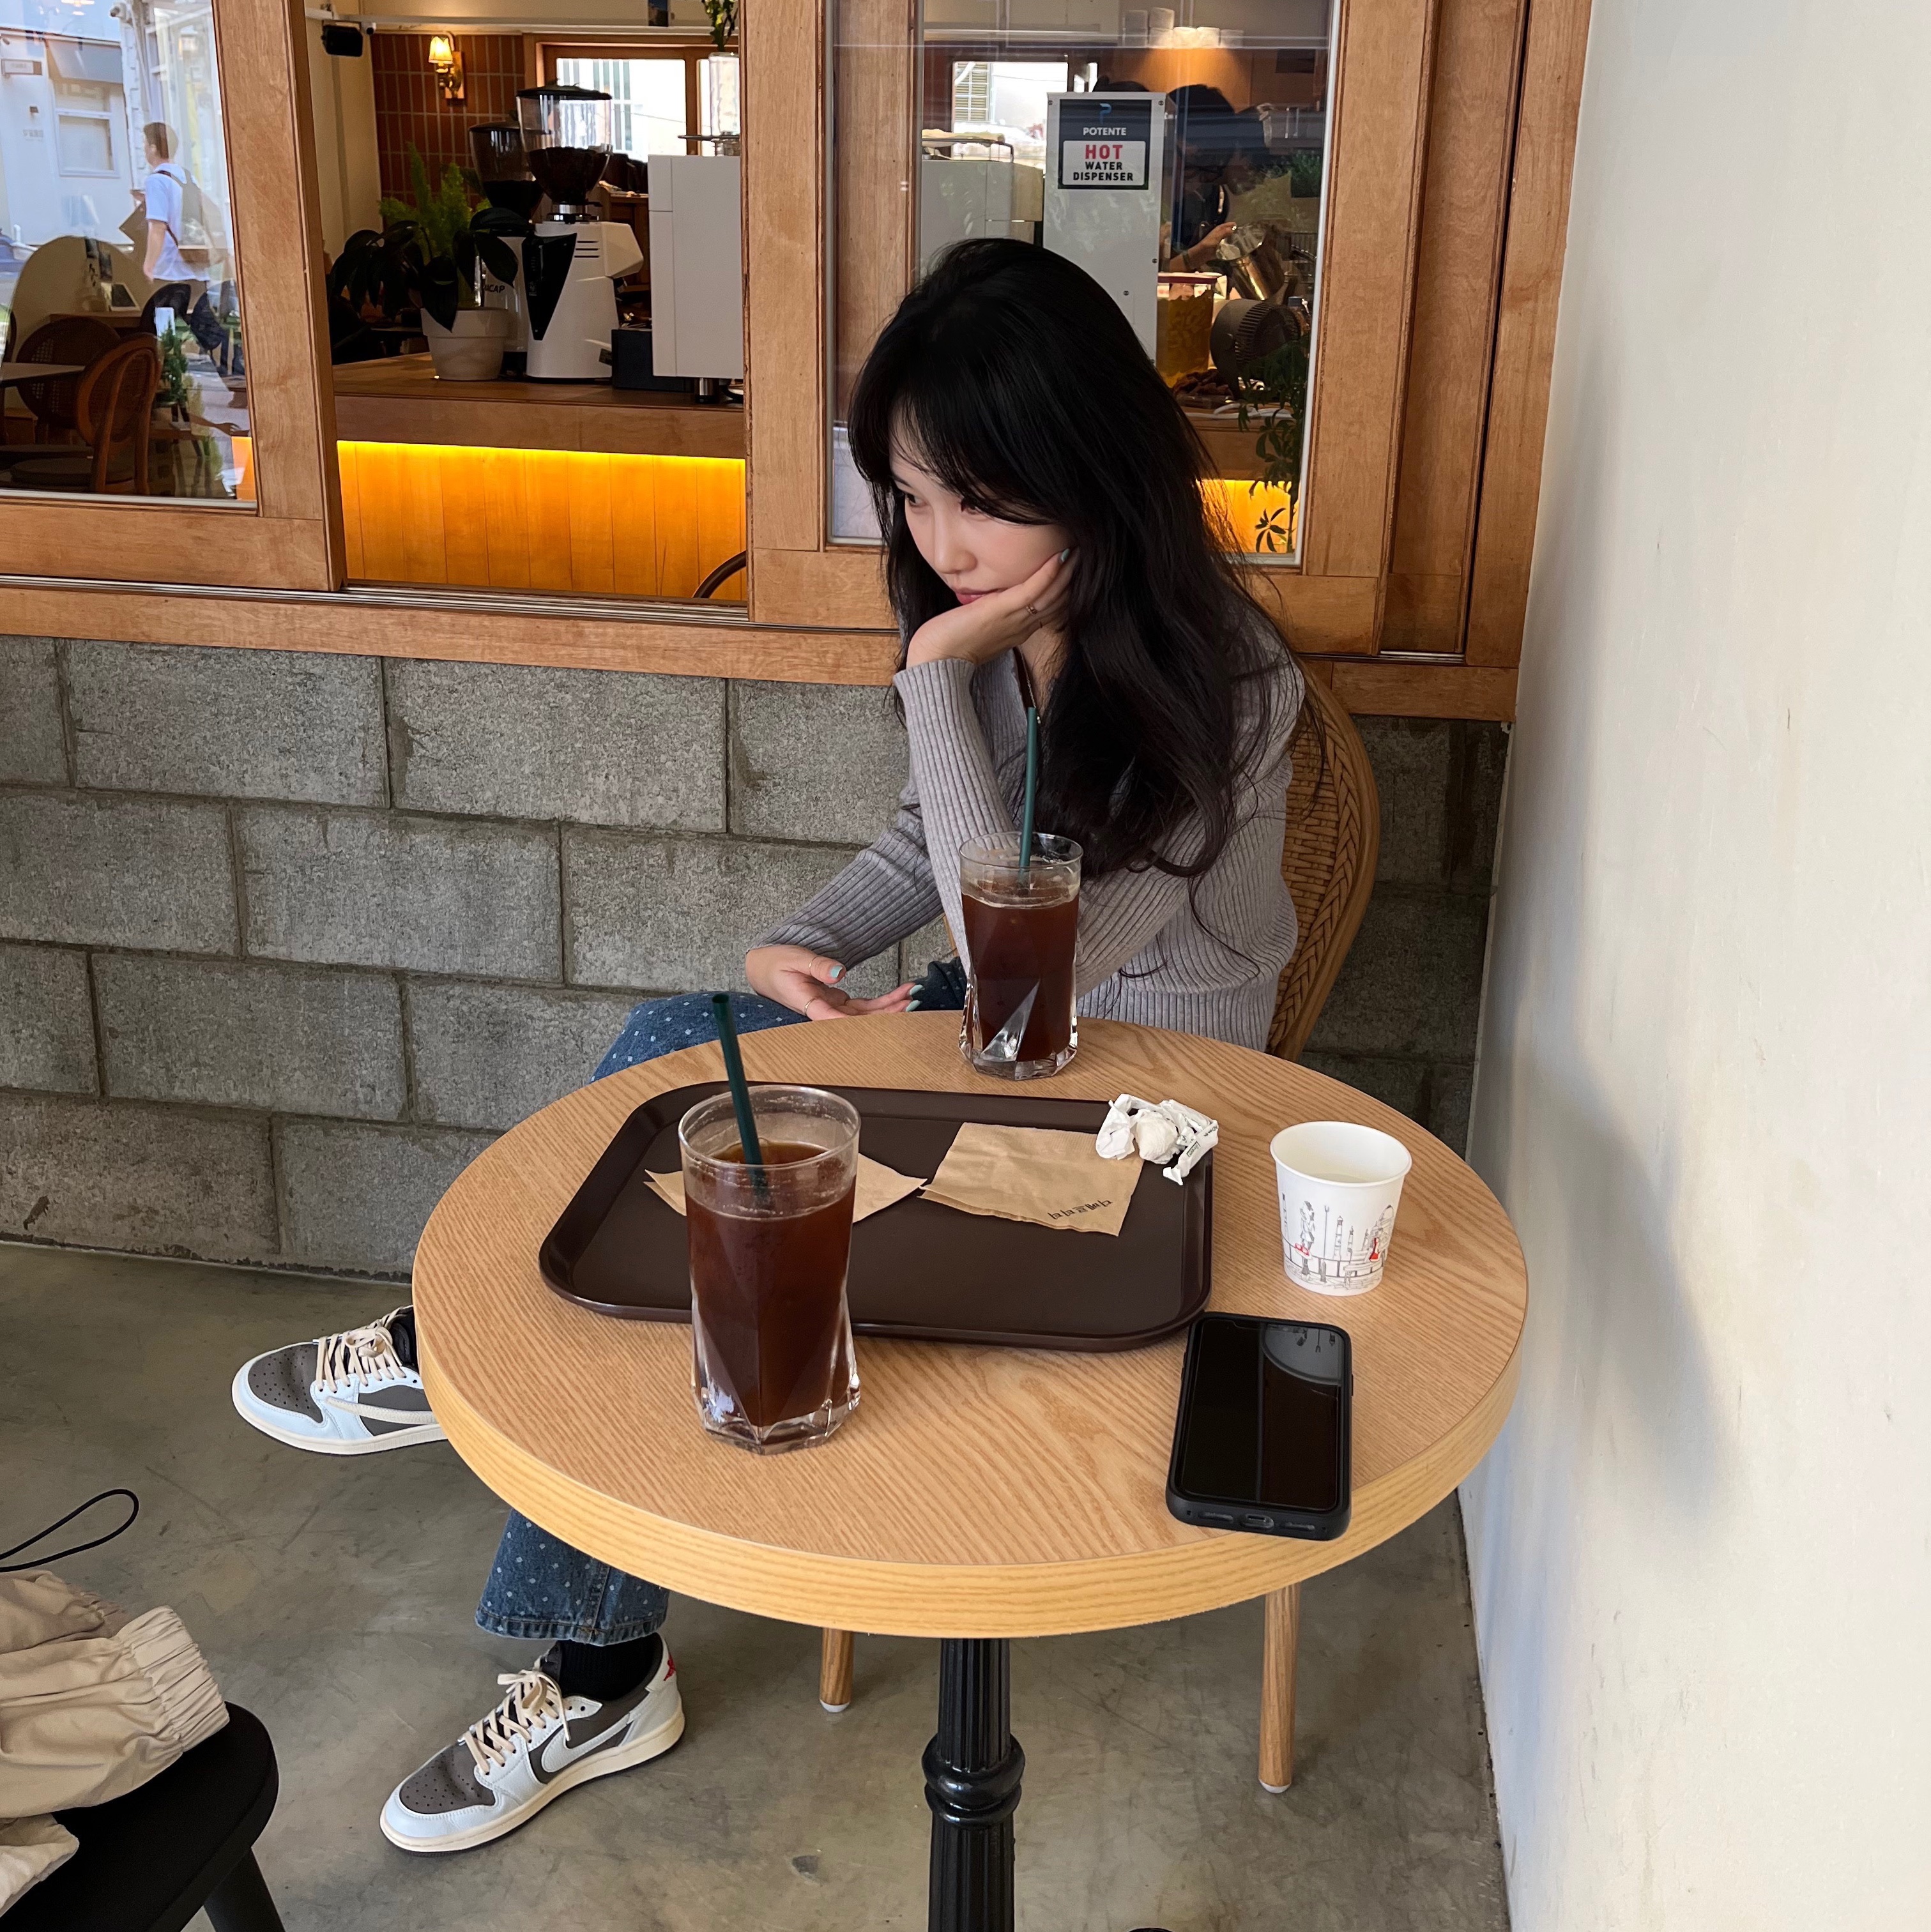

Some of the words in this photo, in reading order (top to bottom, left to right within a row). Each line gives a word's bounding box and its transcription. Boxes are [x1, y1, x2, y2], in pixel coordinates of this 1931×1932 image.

[1083, 127, 1127, 136] POTENTE
[1085, 144, 1123, 160] HOT
[1085, 162, 1123, 170] WATER
[1073, 172, 1134, 181] DISPENSER
